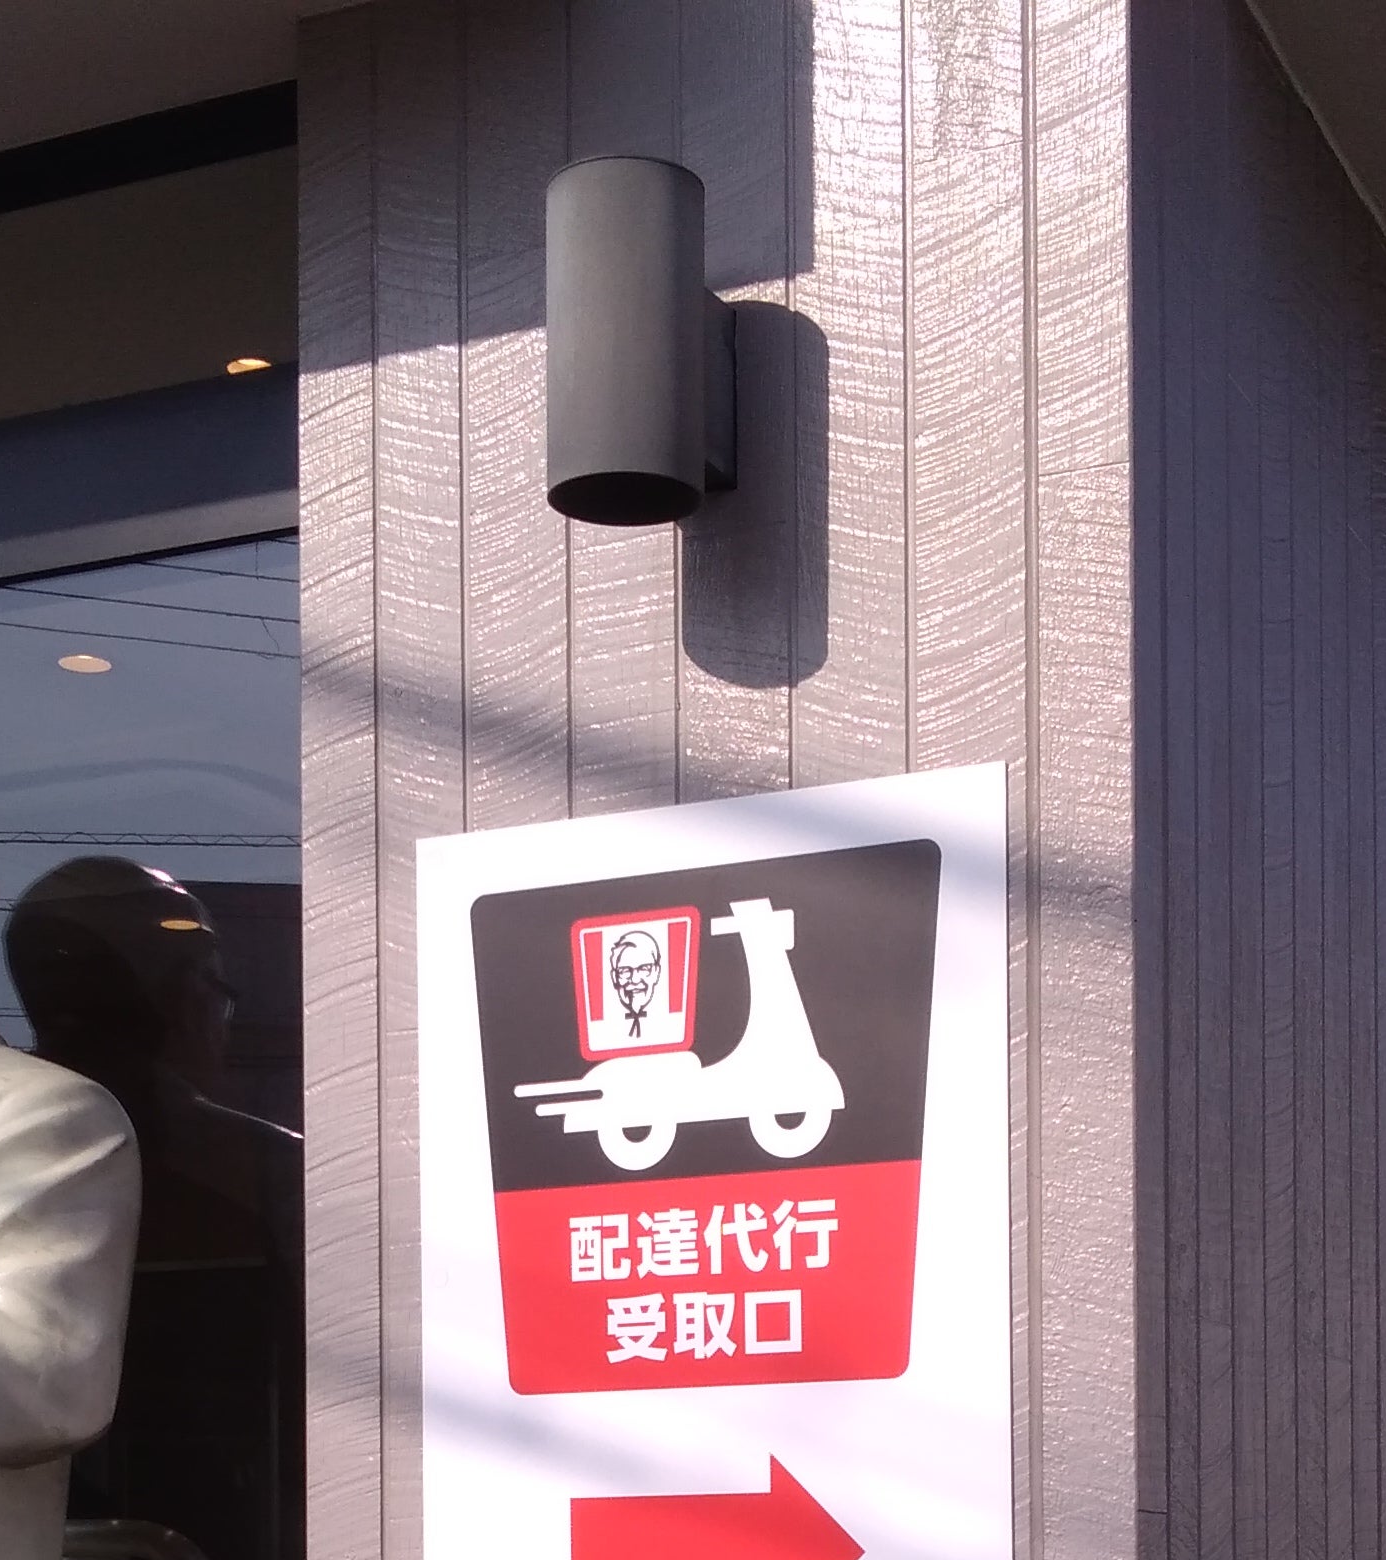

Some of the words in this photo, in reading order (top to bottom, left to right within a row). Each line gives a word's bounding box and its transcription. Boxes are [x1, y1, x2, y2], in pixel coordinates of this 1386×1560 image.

[569, 1199, 839, 1282] 配達代行
[606, 1289, 803, 1364] 受取口
